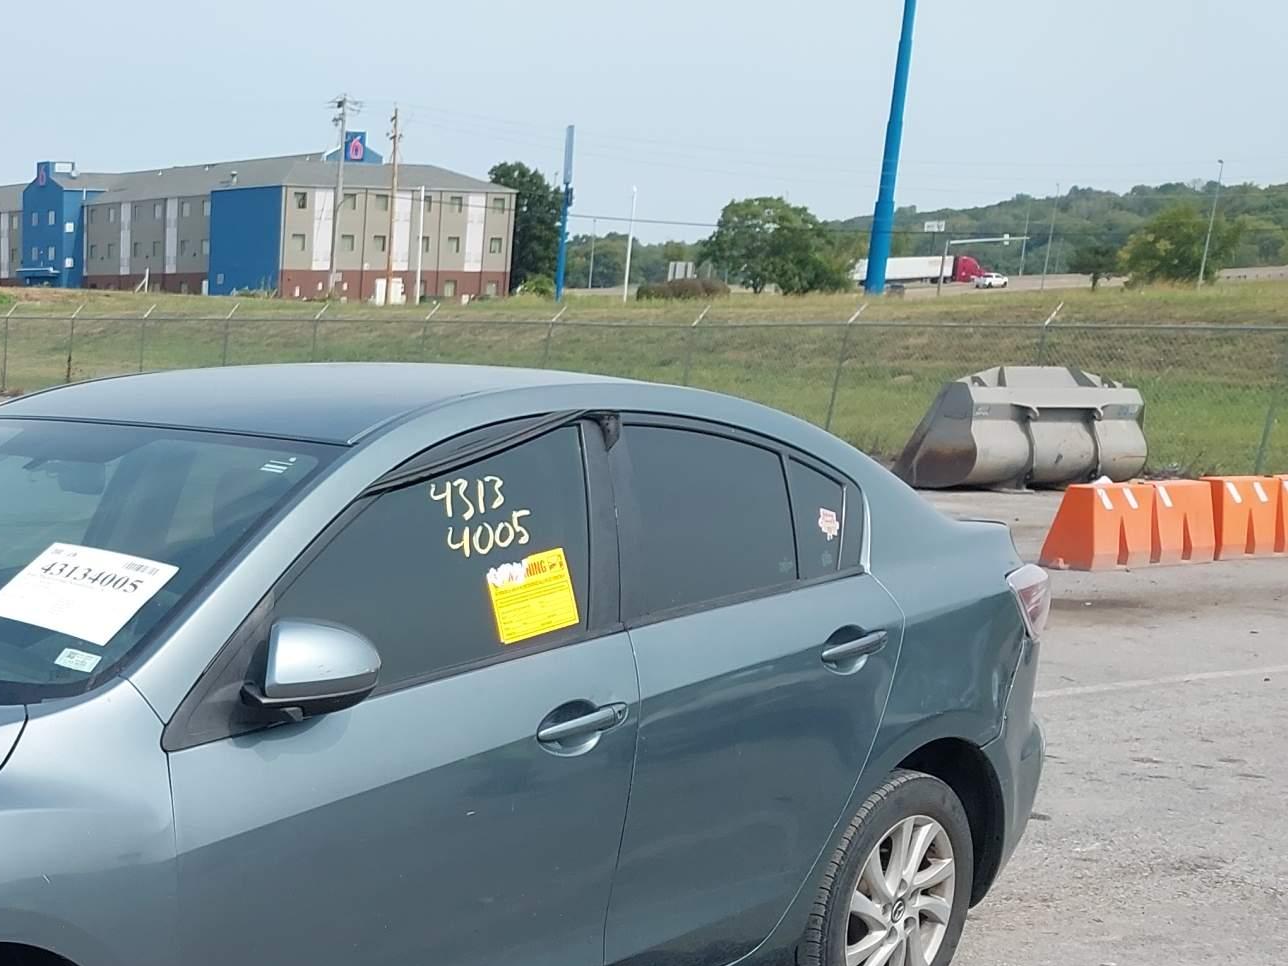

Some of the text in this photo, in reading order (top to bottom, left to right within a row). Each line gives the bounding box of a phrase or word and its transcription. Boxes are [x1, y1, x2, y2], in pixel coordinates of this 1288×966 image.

[349, 135, 364, 160] 6
[429, 475, 505, 521] 4313
[446, 509, 531, 558] 4005
[40, 561, 145, 593] 43134005
